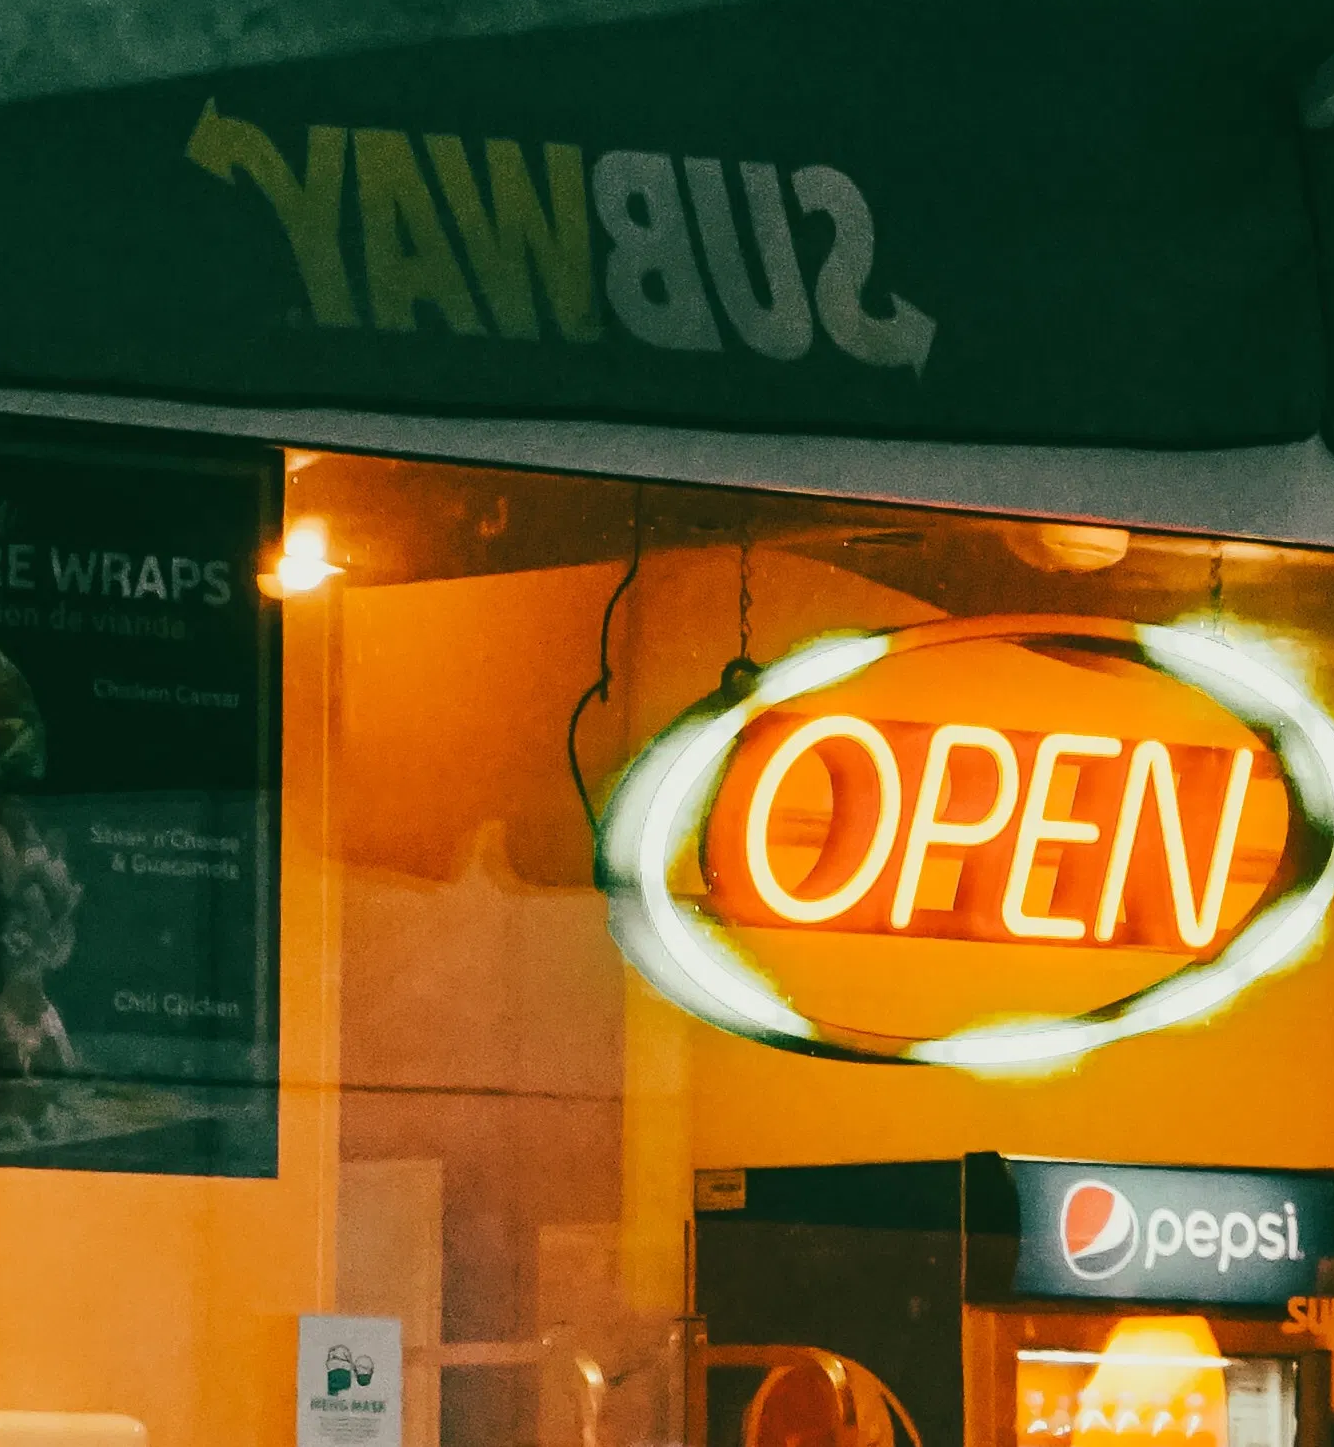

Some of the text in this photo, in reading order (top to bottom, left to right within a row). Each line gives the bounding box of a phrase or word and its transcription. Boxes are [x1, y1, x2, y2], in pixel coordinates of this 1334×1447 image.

[51, 546, 231, 605] WRAPS
[50, 601, 81, 630] de
[747, 715, 1255, 948] OPEN
[1144, 1201, 1301, 1273] pepsi
